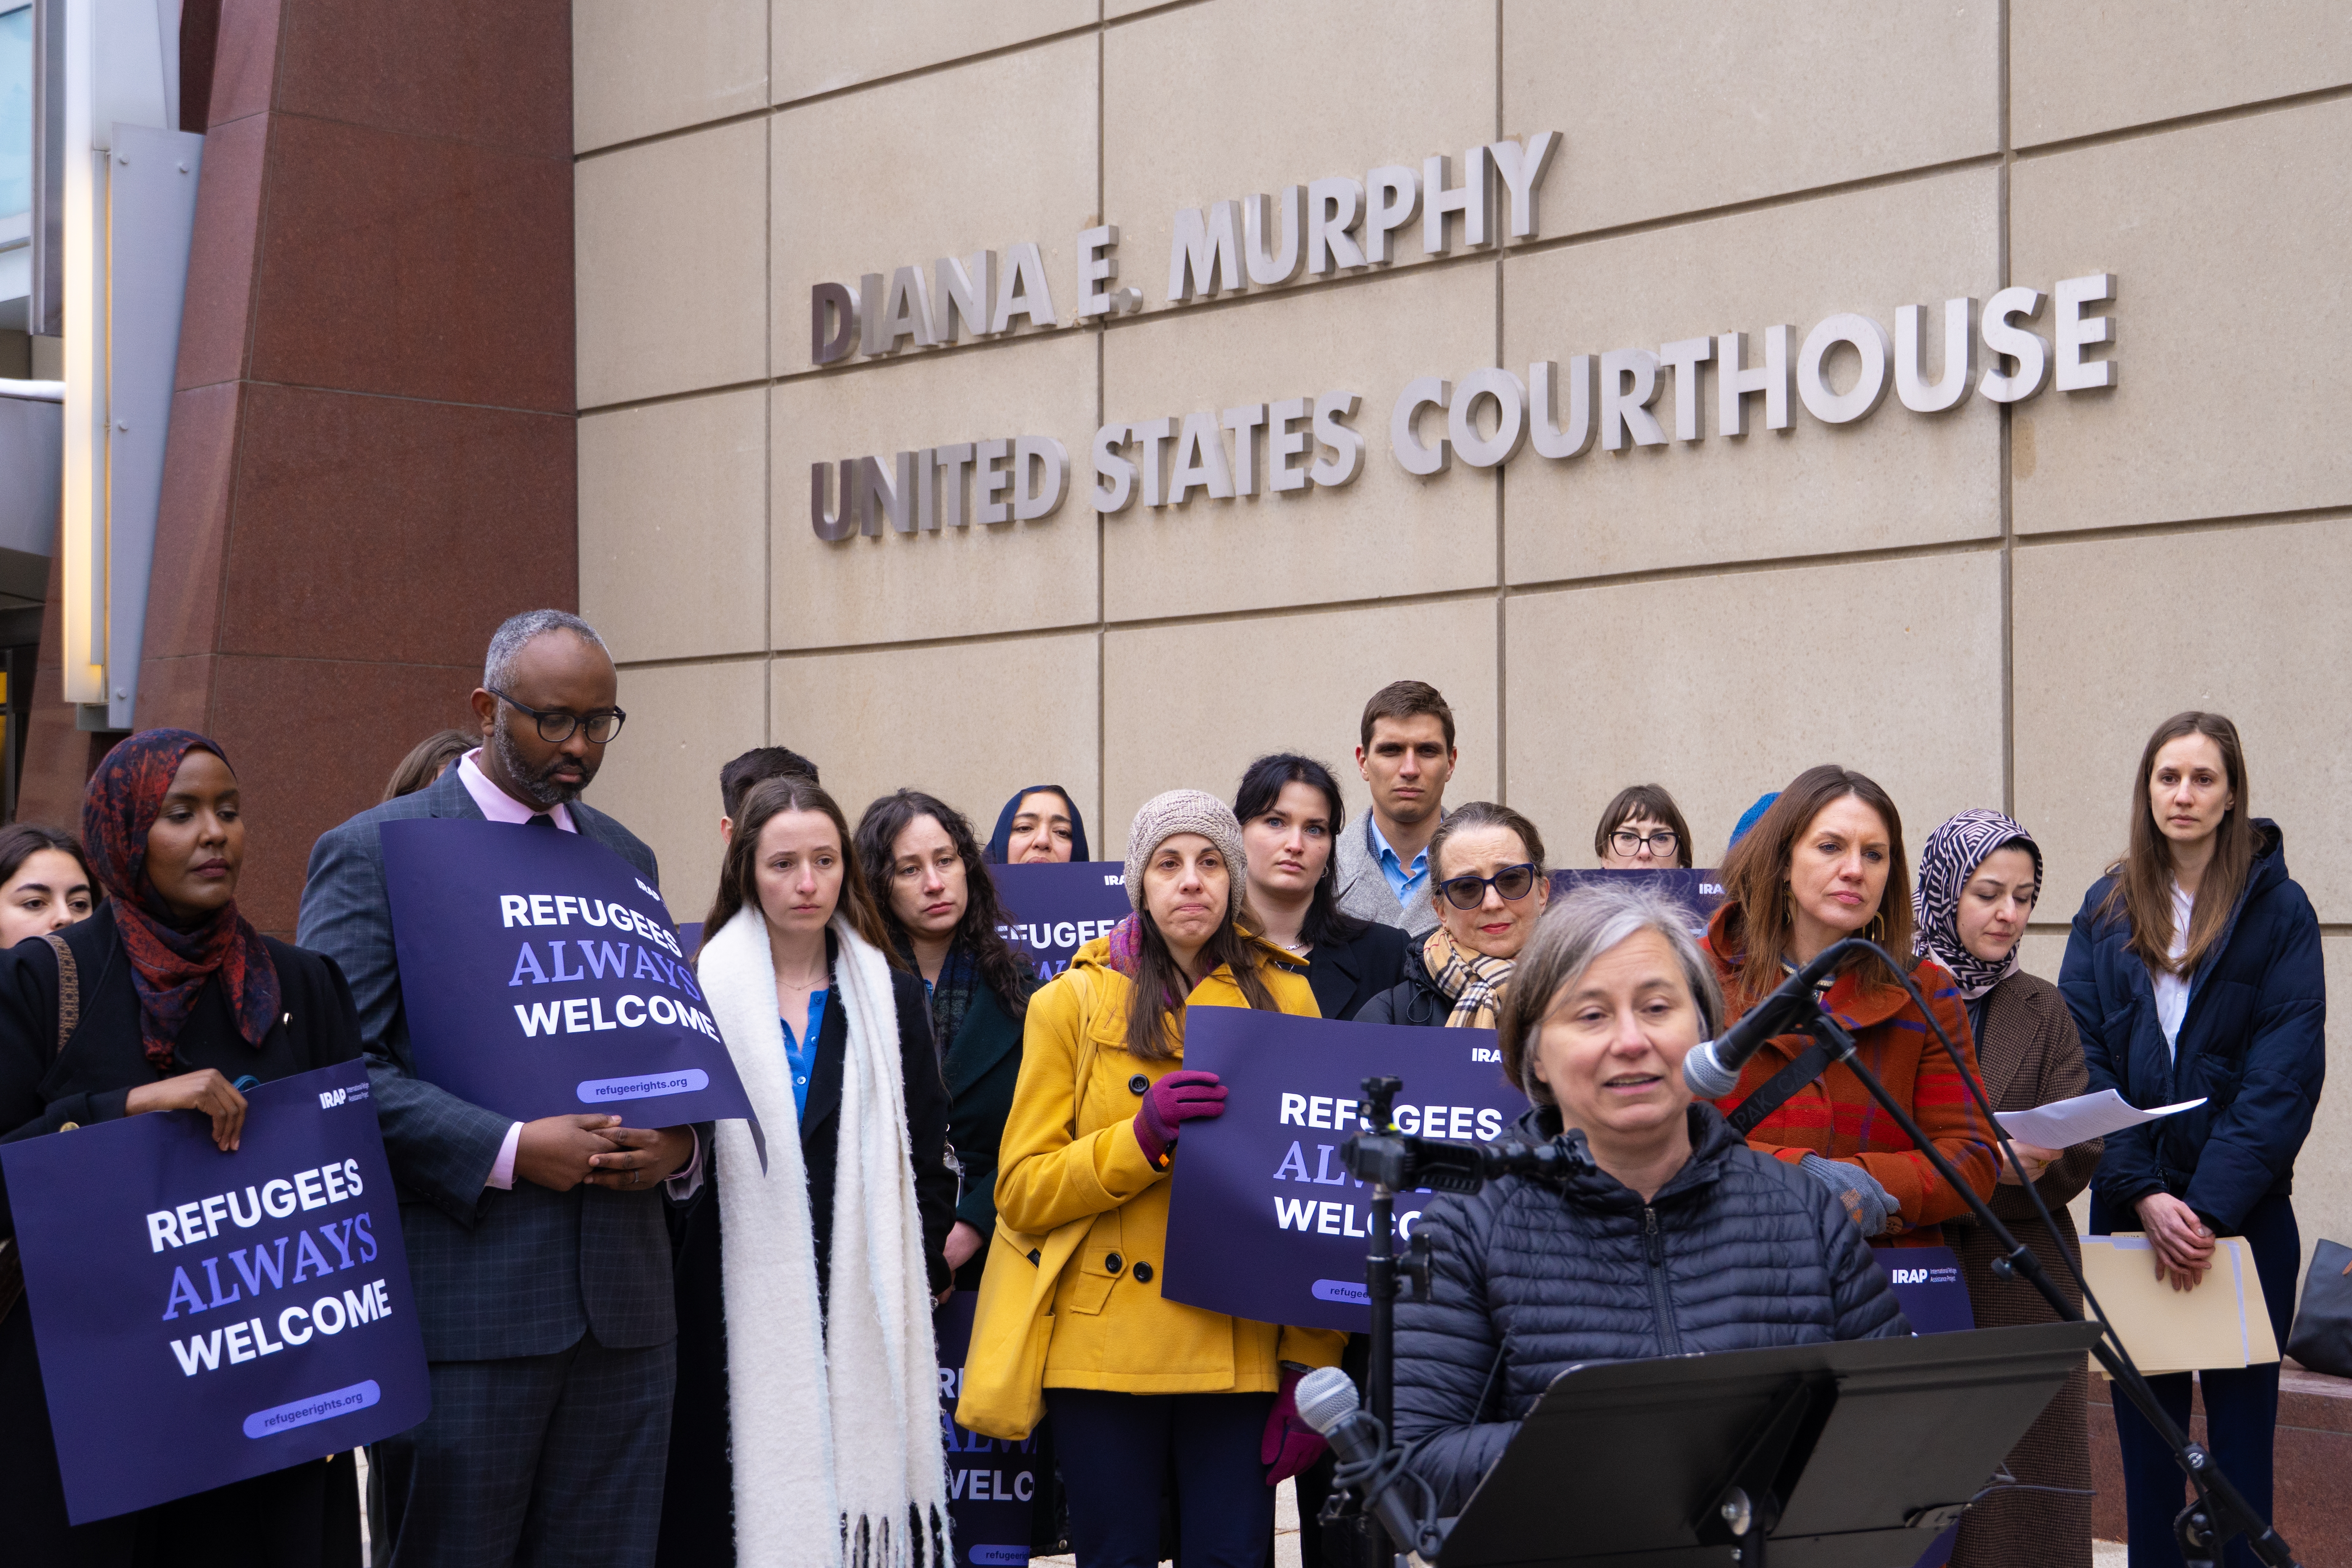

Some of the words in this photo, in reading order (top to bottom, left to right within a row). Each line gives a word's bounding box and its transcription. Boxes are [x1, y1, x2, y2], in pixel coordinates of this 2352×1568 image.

[812, 242, 1057, 365] DIANA
[1077, 225, 1143, 318] E.
[1168, 131, 1563, 302] MURPHY
[812, 435, 1070, 542] UNITED
[1094, 390, 1365, 513] STATES
[1391, 274, 2117, 475] COURTHOUSE
[635, 877, 660, 901] IRAP
[1104, 875, 1125, 886] IRA
[1699, 883, 1725, 894] IRA
[500, 894, 682, 958] REFUGEES
[509, 940, 701, 1001] ALWAYS
[514, 995, 721, 1043] WELCOME
[1472, 1048, 1502, 1063] IRA
[319, 1088, 346, 1109] IRAP
[596, 1077, 687, 1095] refugeerights.org
[147, 1158, 363, 1253] REFUGEES
[163, 1212, 377, 1321] ALWAYS
[1893, 1269, 1928, 1283] IRAP
[170, 1279, 392, 1377] WELCOME
[265, 1393, 363, 1427] refugeerights.org
